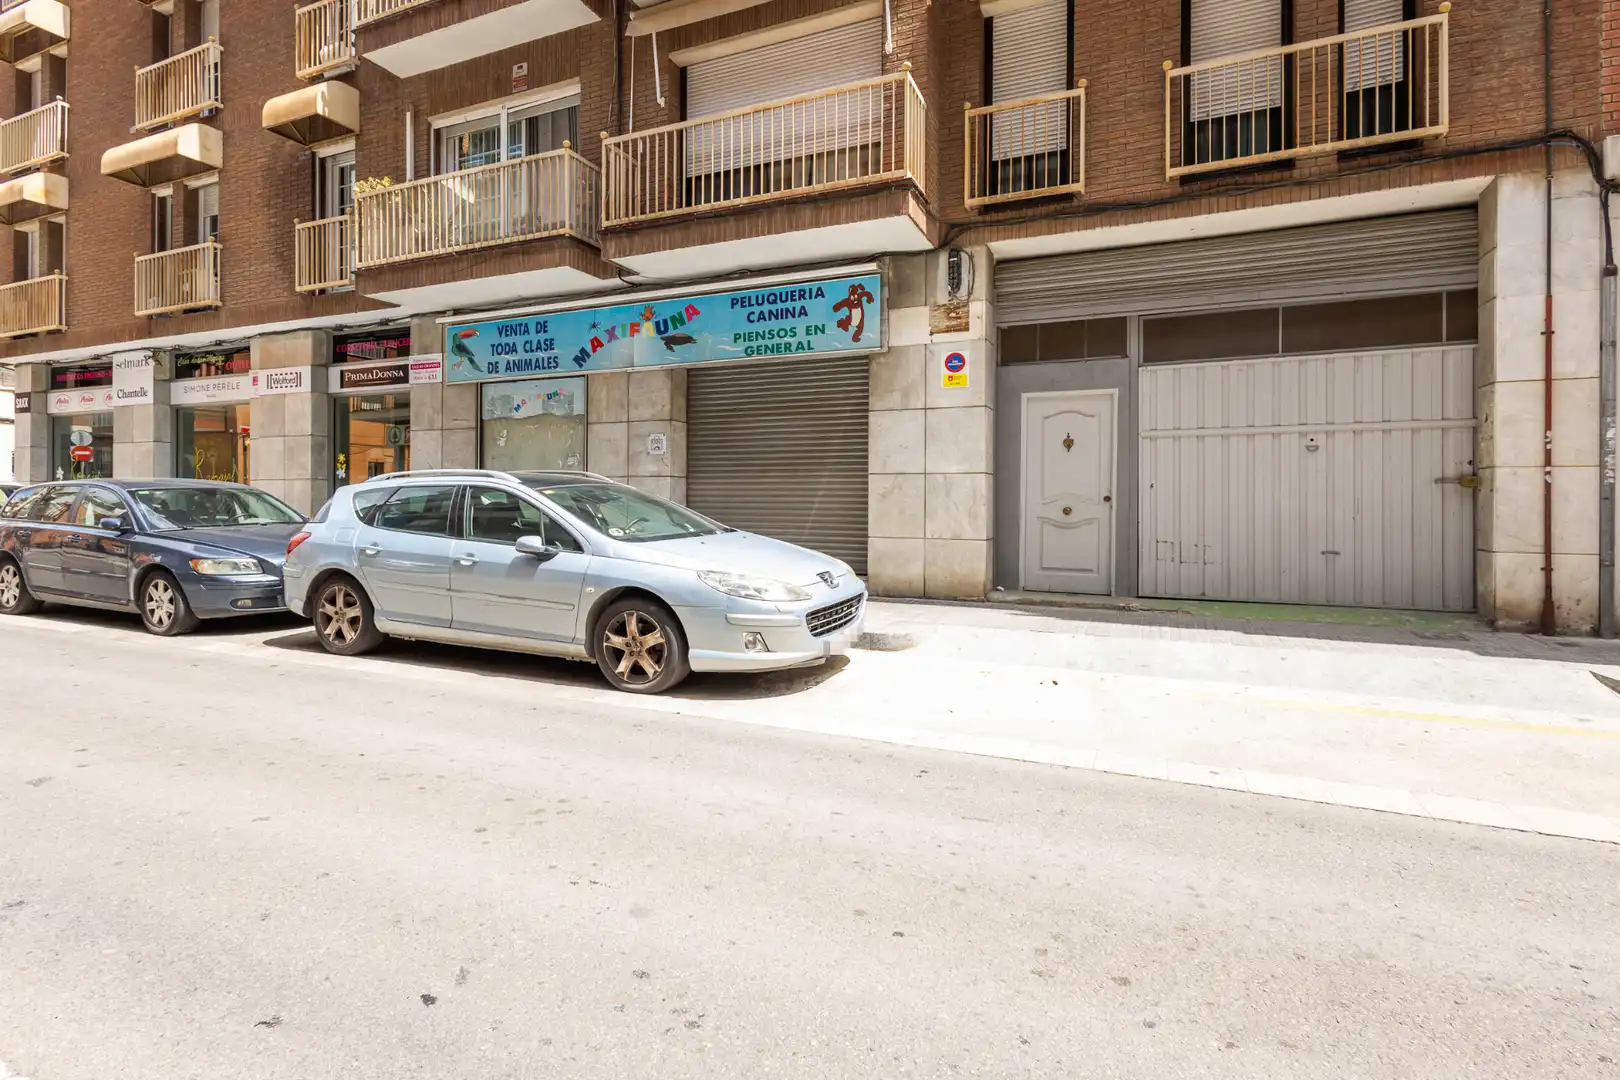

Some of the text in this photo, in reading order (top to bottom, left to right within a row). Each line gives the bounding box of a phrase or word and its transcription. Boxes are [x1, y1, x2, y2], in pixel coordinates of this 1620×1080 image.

[731, 287, 825, 309] PELUQUERIA
[746, 305, 809, 323] CANINA
[497, 320, 549, 338] VENTA DE
[572, 303, 701, 369] MAXIFAUNA
[733, 324, 826, 343] PIENSOS EN
[490, 338, 555, 356] TODA CLASE
[744, 340, 814, 357] GENERAL
[487, 356, 559, 375] DE ANIMALES
[116, 387, 148, 399] Chantelle
[183, 385, 211, 394] SIMONE
[513, 386, 565, 413] MAFAUNA
